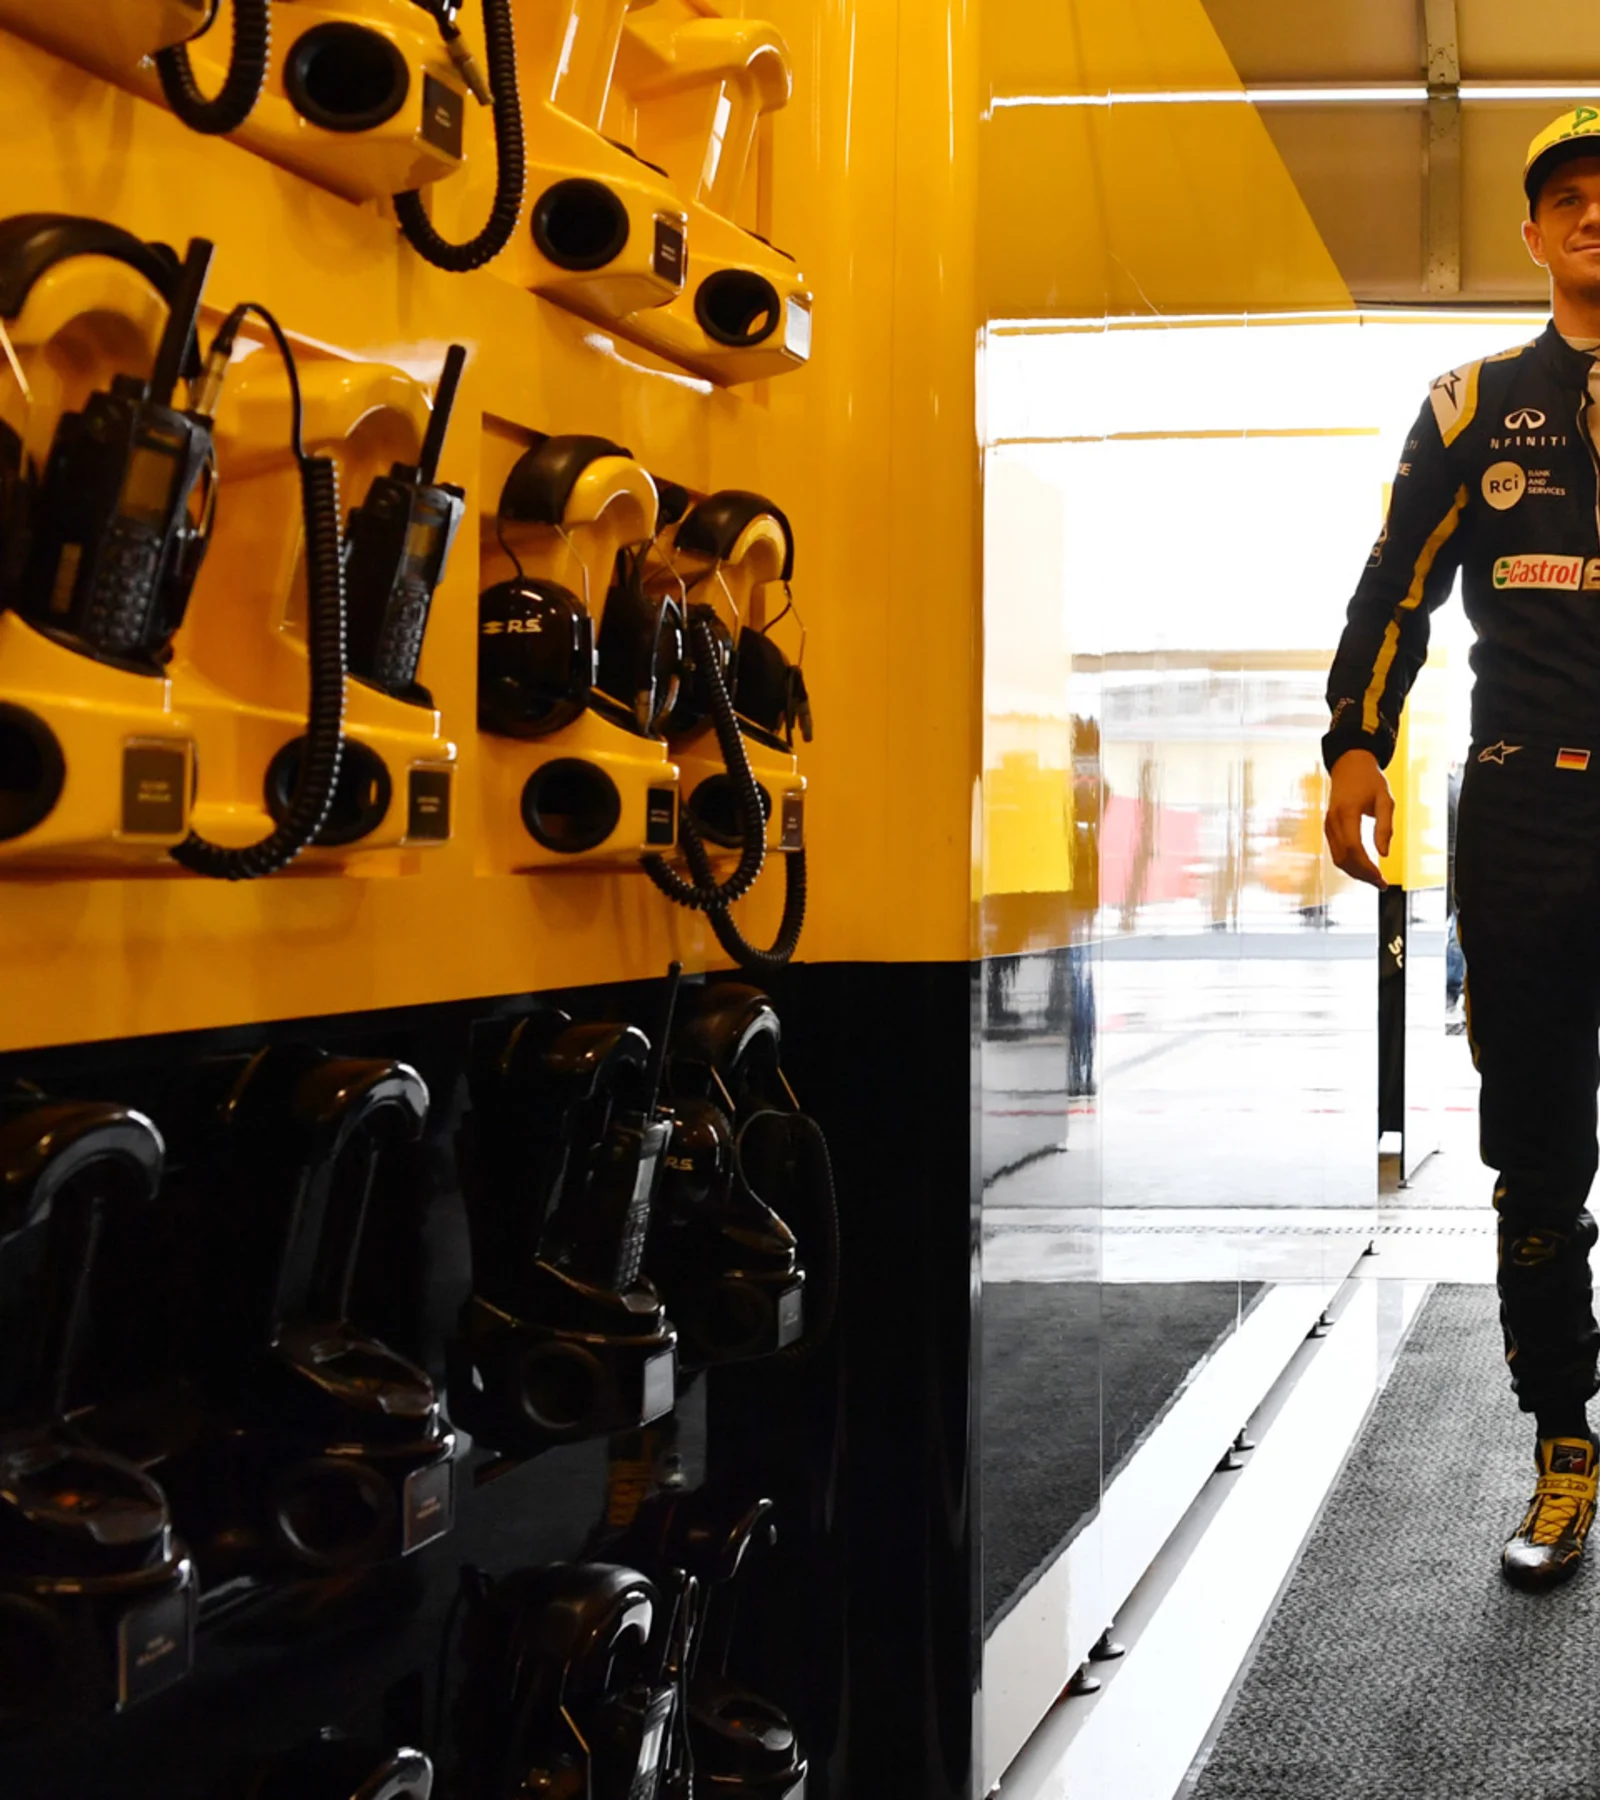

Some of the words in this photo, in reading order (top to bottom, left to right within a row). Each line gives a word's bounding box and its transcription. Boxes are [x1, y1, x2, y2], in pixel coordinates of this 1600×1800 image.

[1489, 435, 1567, 450] NFINITI
[1527, 478, 1547, 486] AND
[1527, 486, 1566, 497] SERVICES
[1507, 557, 1581, 587] Castrol
